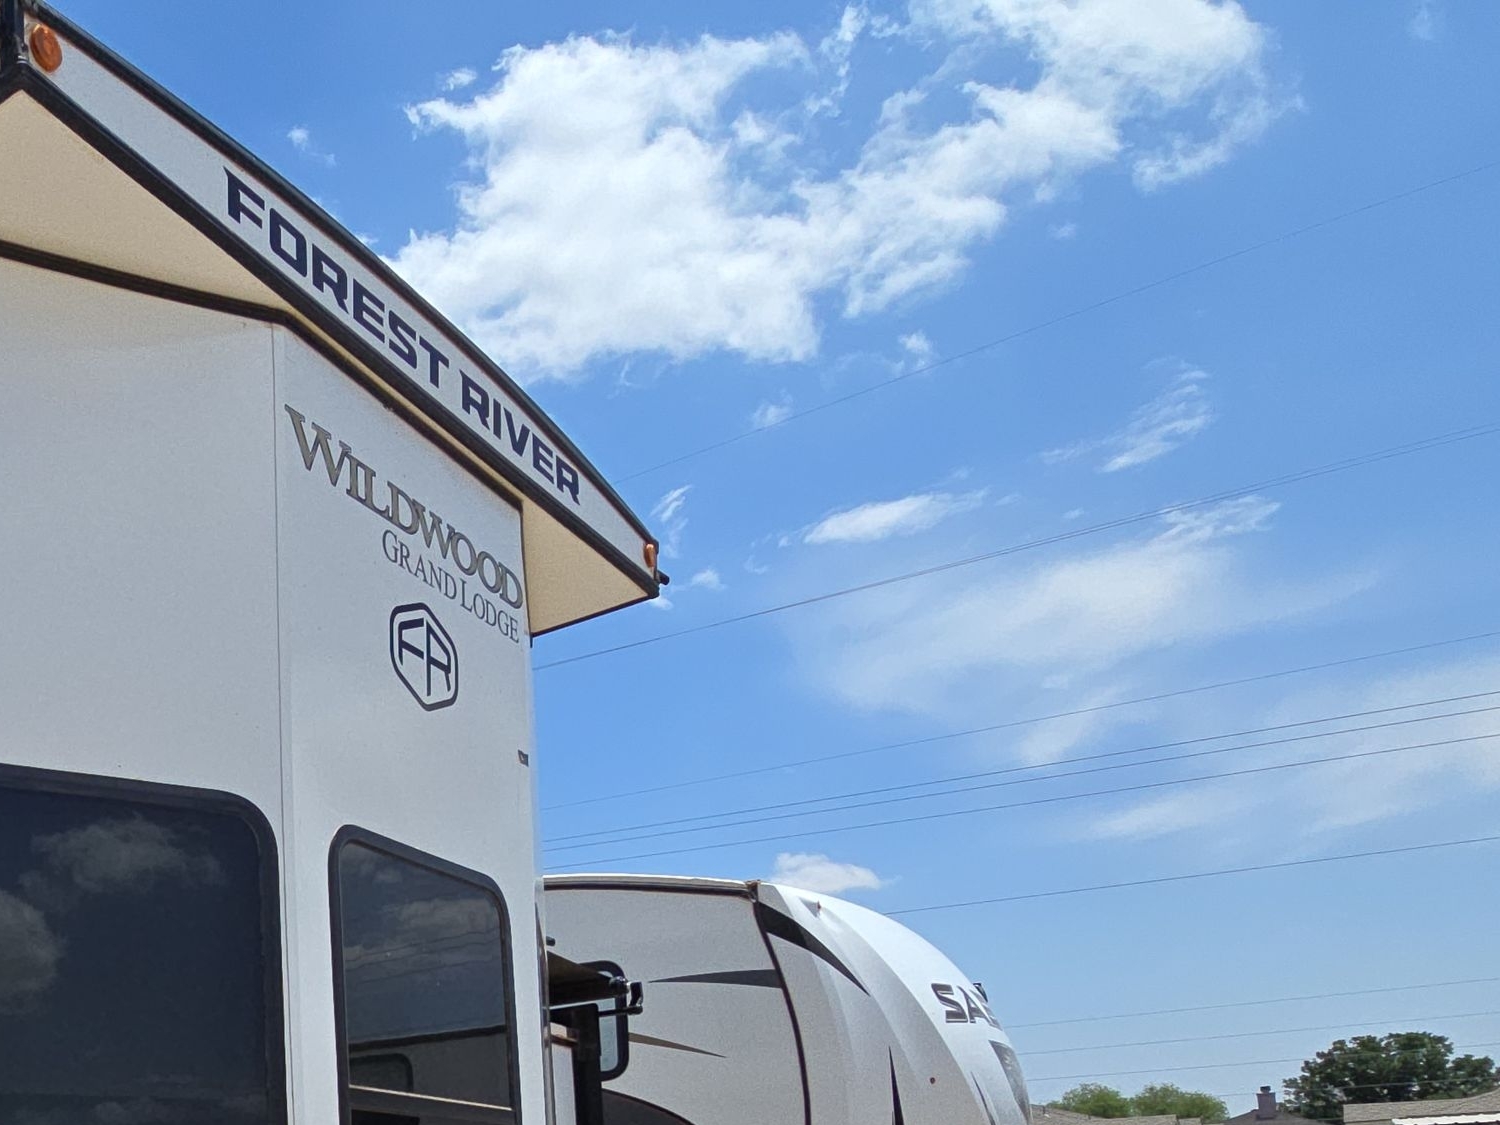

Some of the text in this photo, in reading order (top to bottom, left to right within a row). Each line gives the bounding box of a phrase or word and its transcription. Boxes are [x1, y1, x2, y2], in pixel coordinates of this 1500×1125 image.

[223, 166, 581, 505] FOREST RIVER
[284, 403, 523, 609] WILDWOOD
[382, 529, 520, 644] GRAND LODGE
